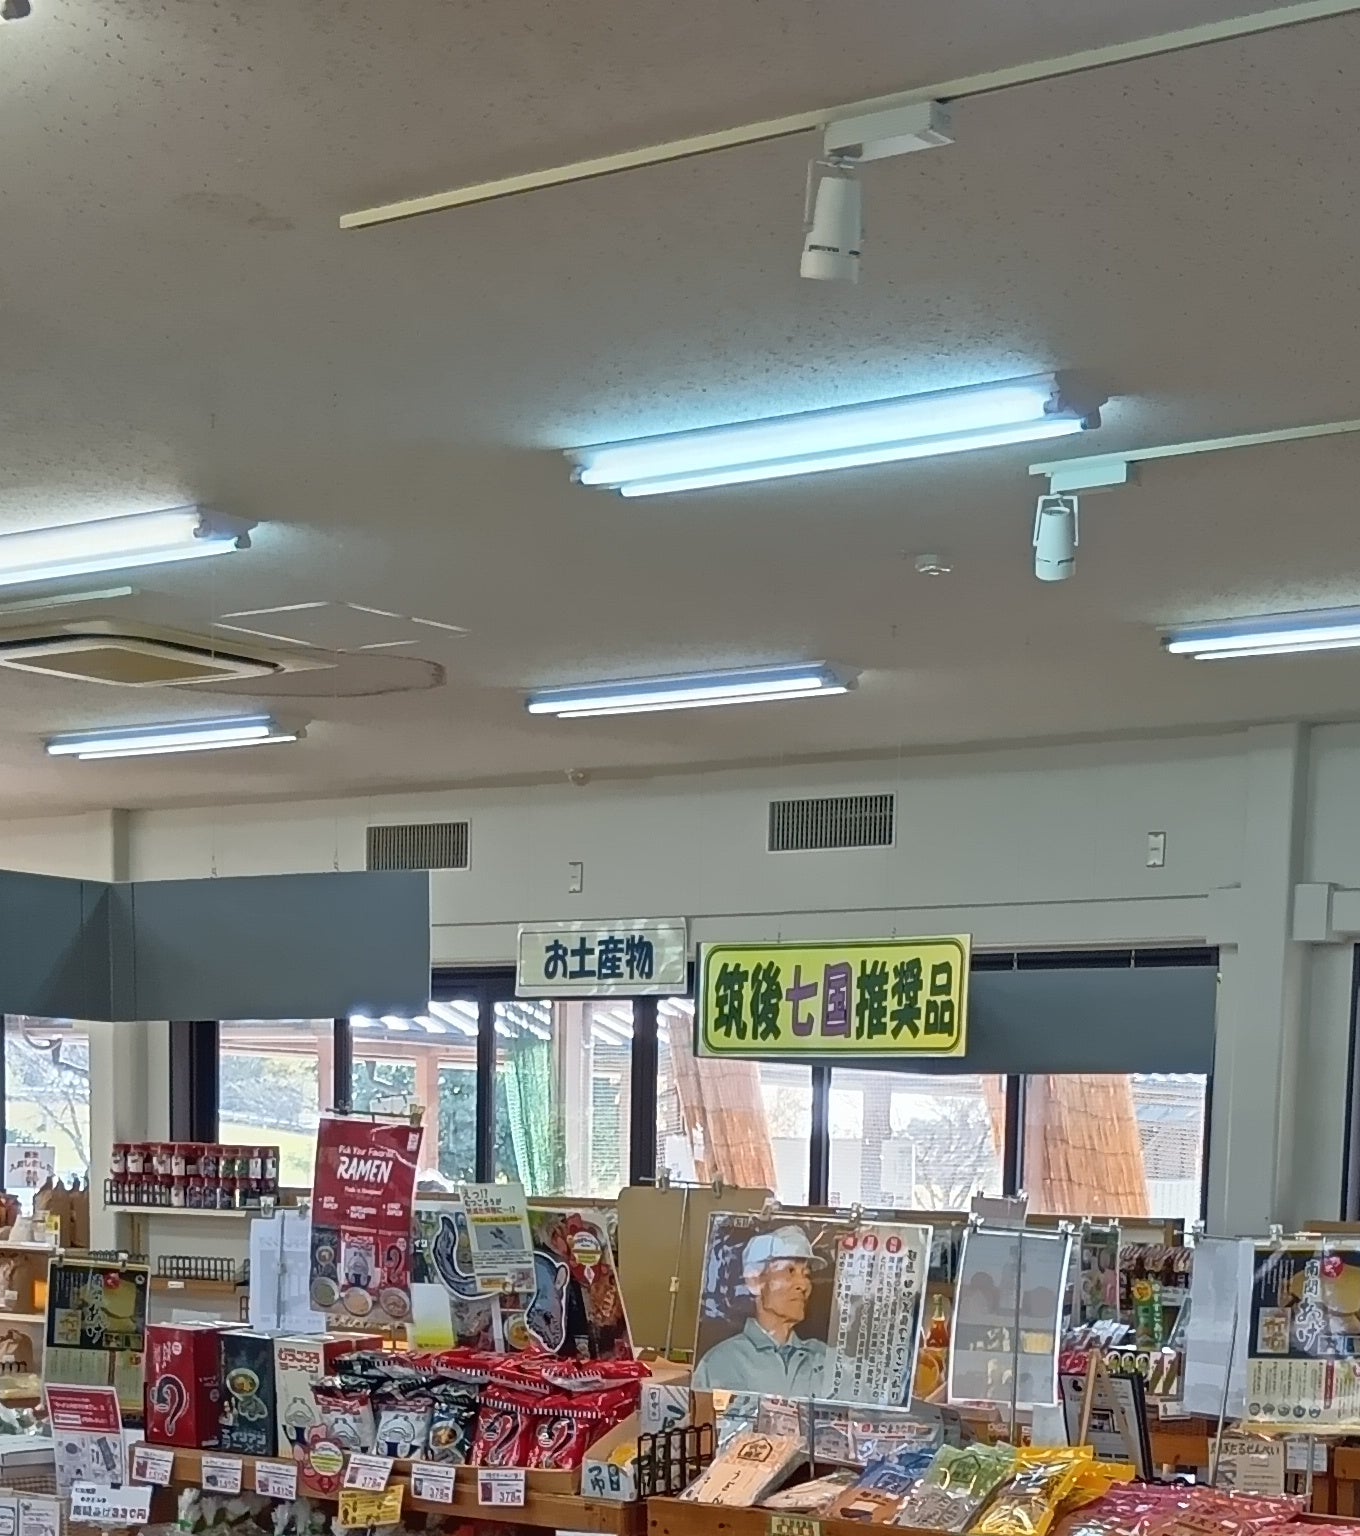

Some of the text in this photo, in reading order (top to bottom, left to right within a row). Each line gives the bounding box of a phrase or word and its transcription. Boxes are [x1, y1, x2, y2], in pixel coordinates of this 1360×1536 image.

[544, 934, 653, 981] お土産物
[714, 958, 955, 1040] 筑後七国推奨品
[337, 1157, 393, 1184] RAMEN
[1296, 1259, 1325, 1351] 南関あげ
